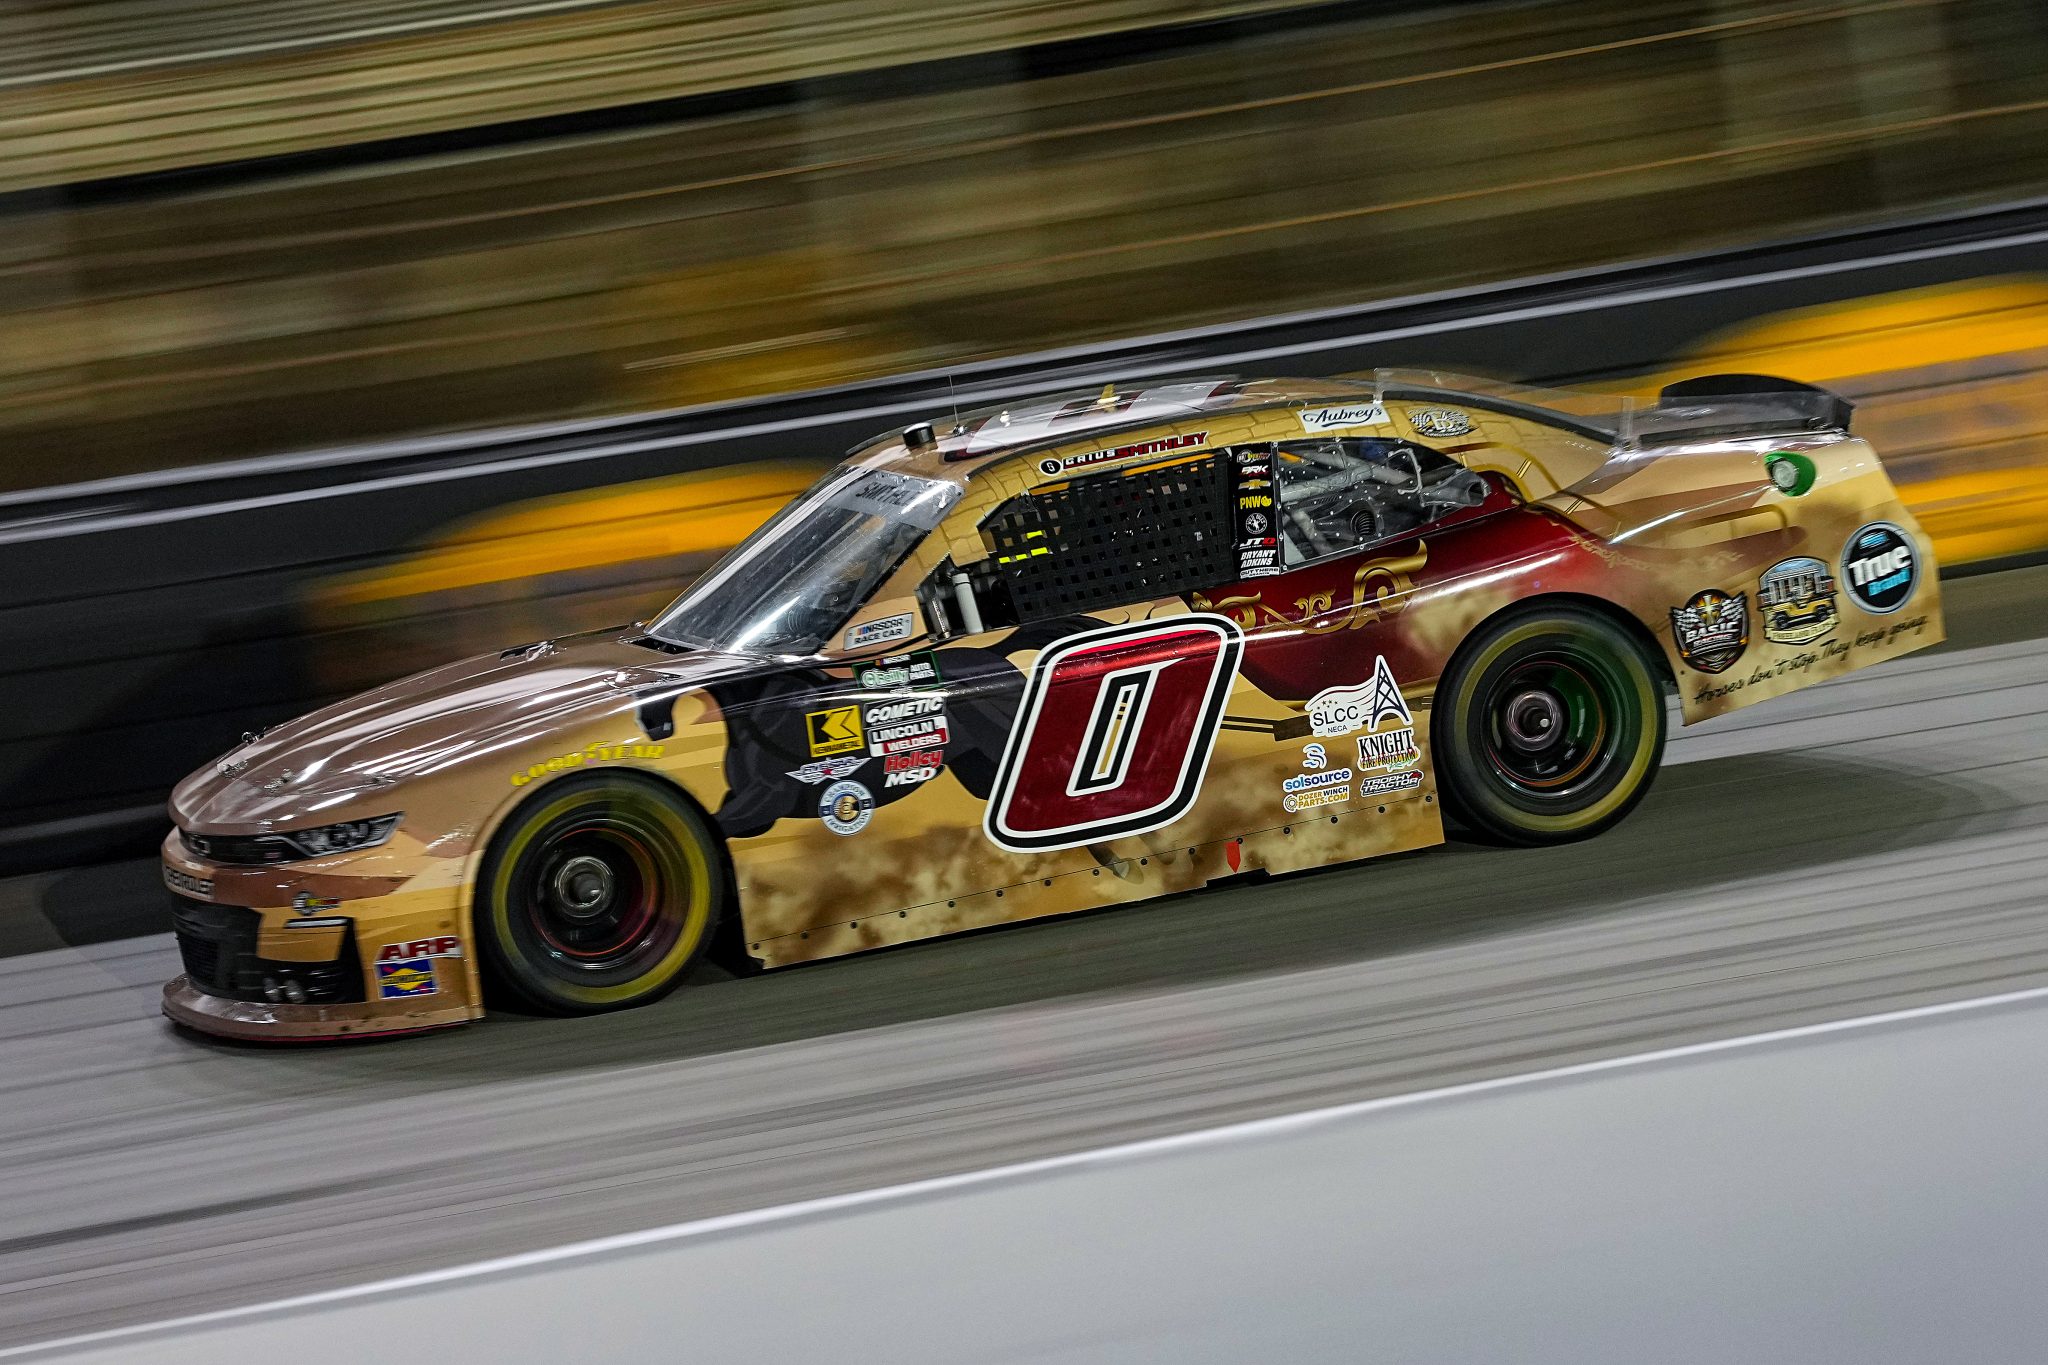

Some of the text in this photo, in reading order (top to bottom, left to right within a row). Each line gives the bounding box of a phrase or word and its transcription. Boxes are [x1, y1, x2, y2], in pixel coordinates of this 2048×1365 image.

[1302, 407, 1383, 427] Aubrey's
[1116, 432, 1208, 458] SMITHLEY
[1240, 495, 1261, 509] PNW
[1240, 550, 1276, 561] BRYANT
[1240, 558, 1274, 569] ADKINS
[866, 619, 904, 634] NASCAR
[1685, 621, 1740, 644] BASIC
[854, 628, 903, 645] RACE CAR
[910, 662, 931, 672] AUTO
[910, 670, 935, 681] PARTS
[1694, 679, 1745, 704] Horses
[1747, 658, 1790, 686] don't
[1820, 638, 1852, 661] They
[1313, 705, 1359, 727] SLCC
[873, 720, 934, 744] LINCOLN
[982, 612, 1245, 854] 0
[1327, 725, 1348, 734] NECA
[887, 734, 942, 752] WELDERS
[1359, 730, 1413, 758] KNIGHT
[885, 750, 944, 774] Holley
[884, 767, 938, 788] MSD
[1285, 770, 1350, 790] solsource
[1363, 777, 1419, 793] TRACTOR
[1365, 773, 1412, 786] TROPHY
[1298, 786, 1349, 801] DOZER WINCH
[1298, 793, 1349, 808] PARTS.COM
